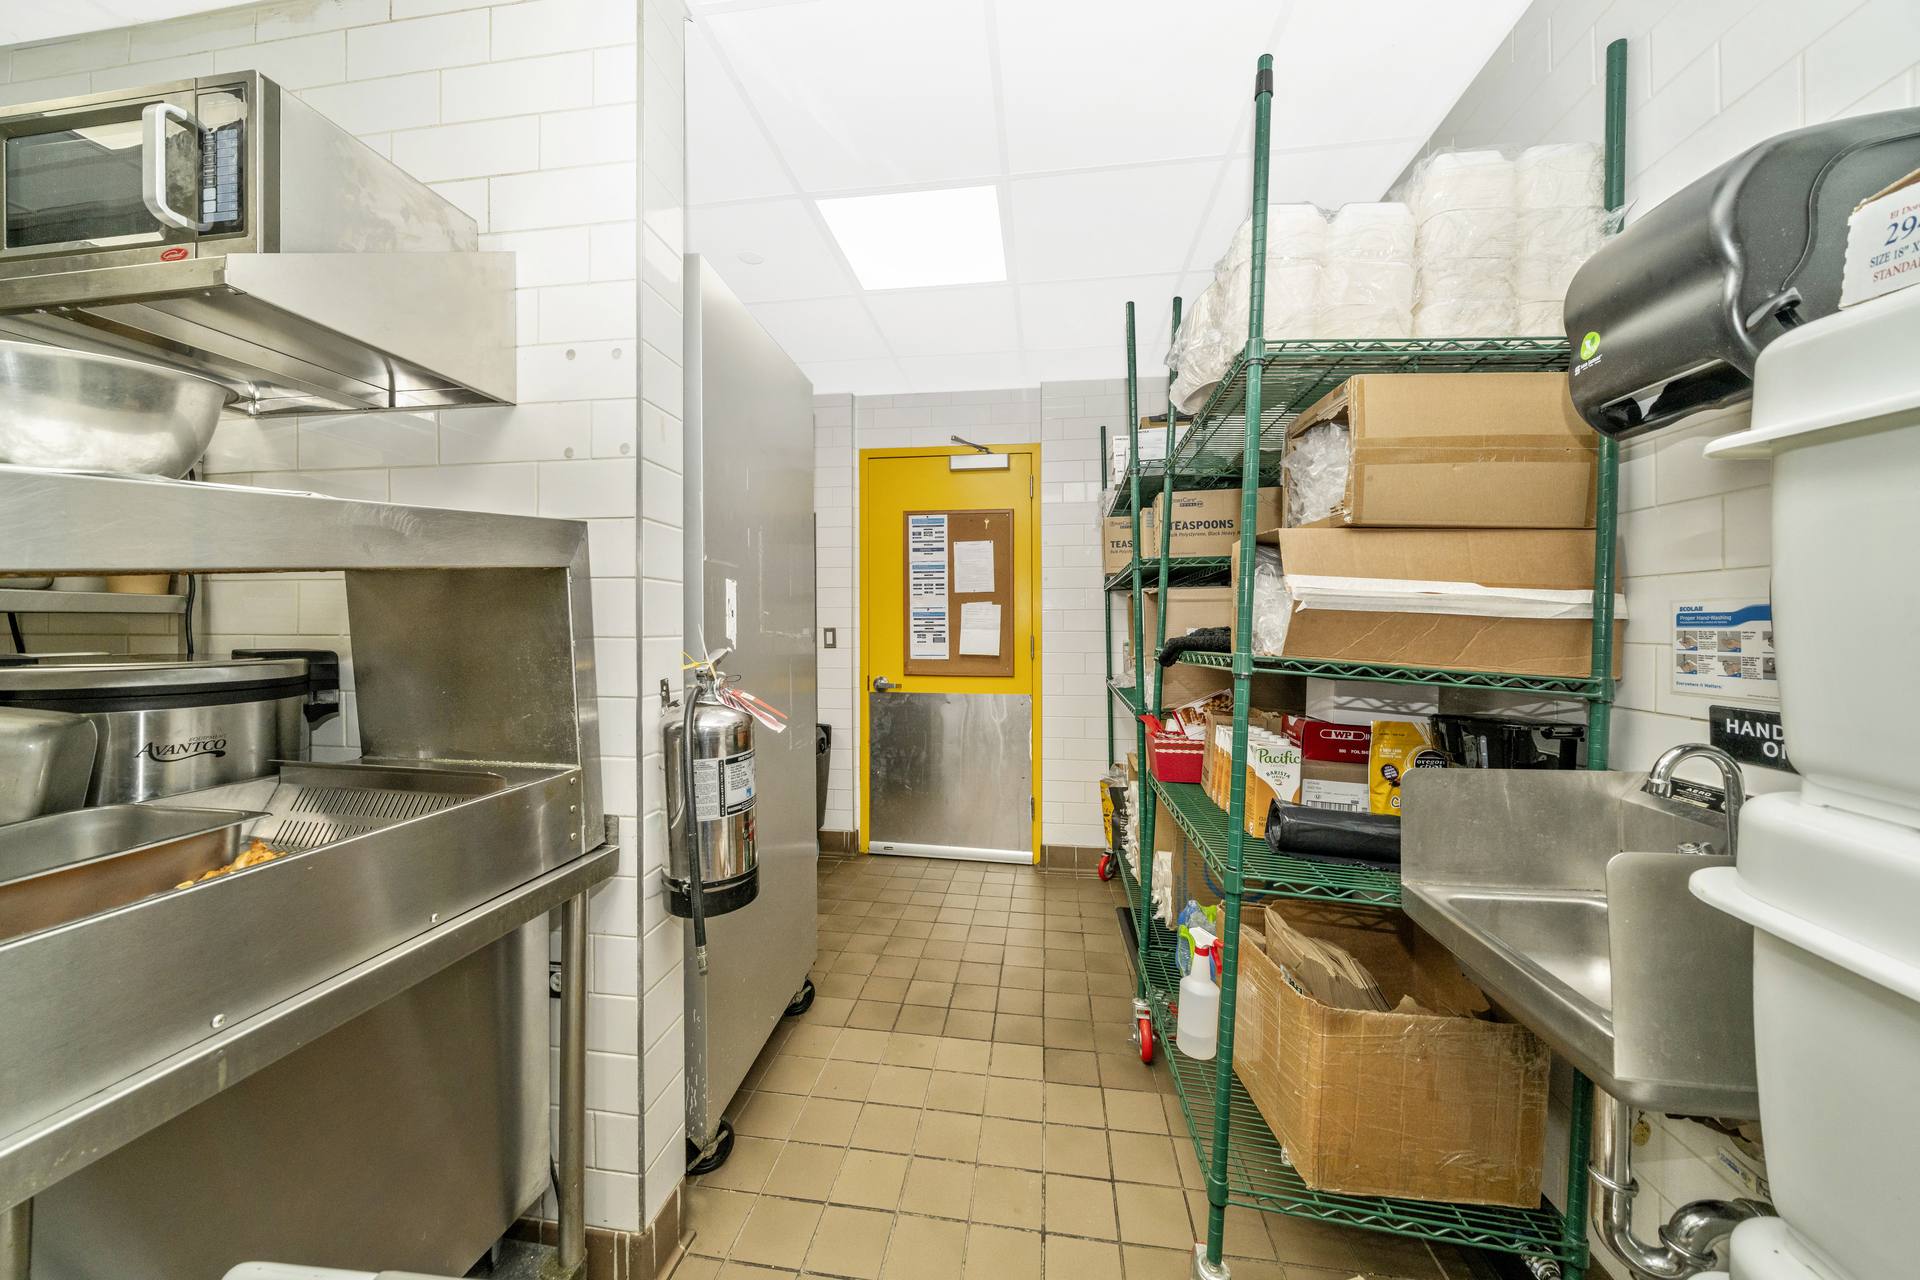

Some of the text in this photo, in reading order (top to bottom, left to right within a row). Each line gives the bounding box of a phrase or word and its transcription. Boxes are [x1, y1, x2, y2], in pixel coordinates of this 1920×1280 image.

[1884, 215, 1920, 246] 29
[1870, 251, 1891, 268] SIZE
[1873, 257, 1920, 282] STANDA
[1333, 731, 1353, 739] WP
[1726, 718, 1784, 740] HAND
[134, 738, 227, 760] AVANTCO
[1256, 748, 1300, 765] Pacific
[1265, 770, 1291, 779] BARISTA
[1686, 787, 1712, 797] AERO
